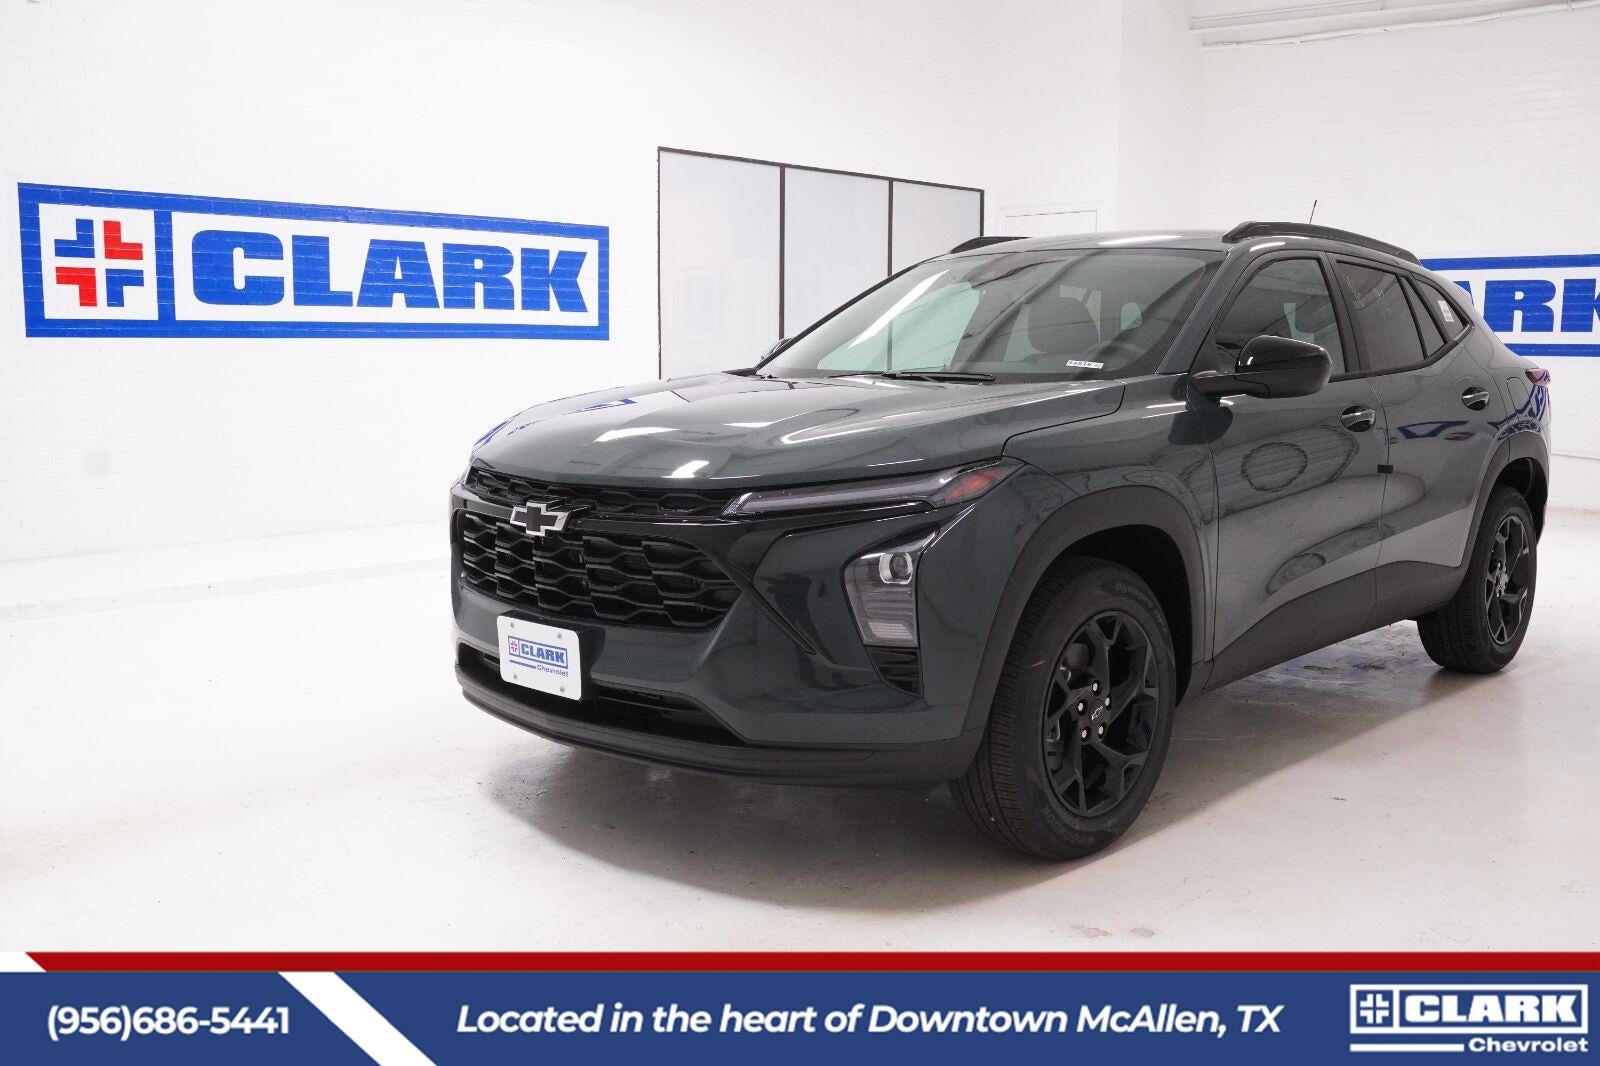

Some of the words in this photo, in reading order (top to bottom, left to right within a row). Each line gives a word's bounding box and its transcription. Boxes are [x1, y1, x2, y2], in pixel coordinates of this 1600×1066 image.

[191, 229, 589, 313] CLARK
[1453, 278, 1600, 333] RK
[520, 643, 566, 664] CLARK
[536, 664, 569, 677] Chevrolet
